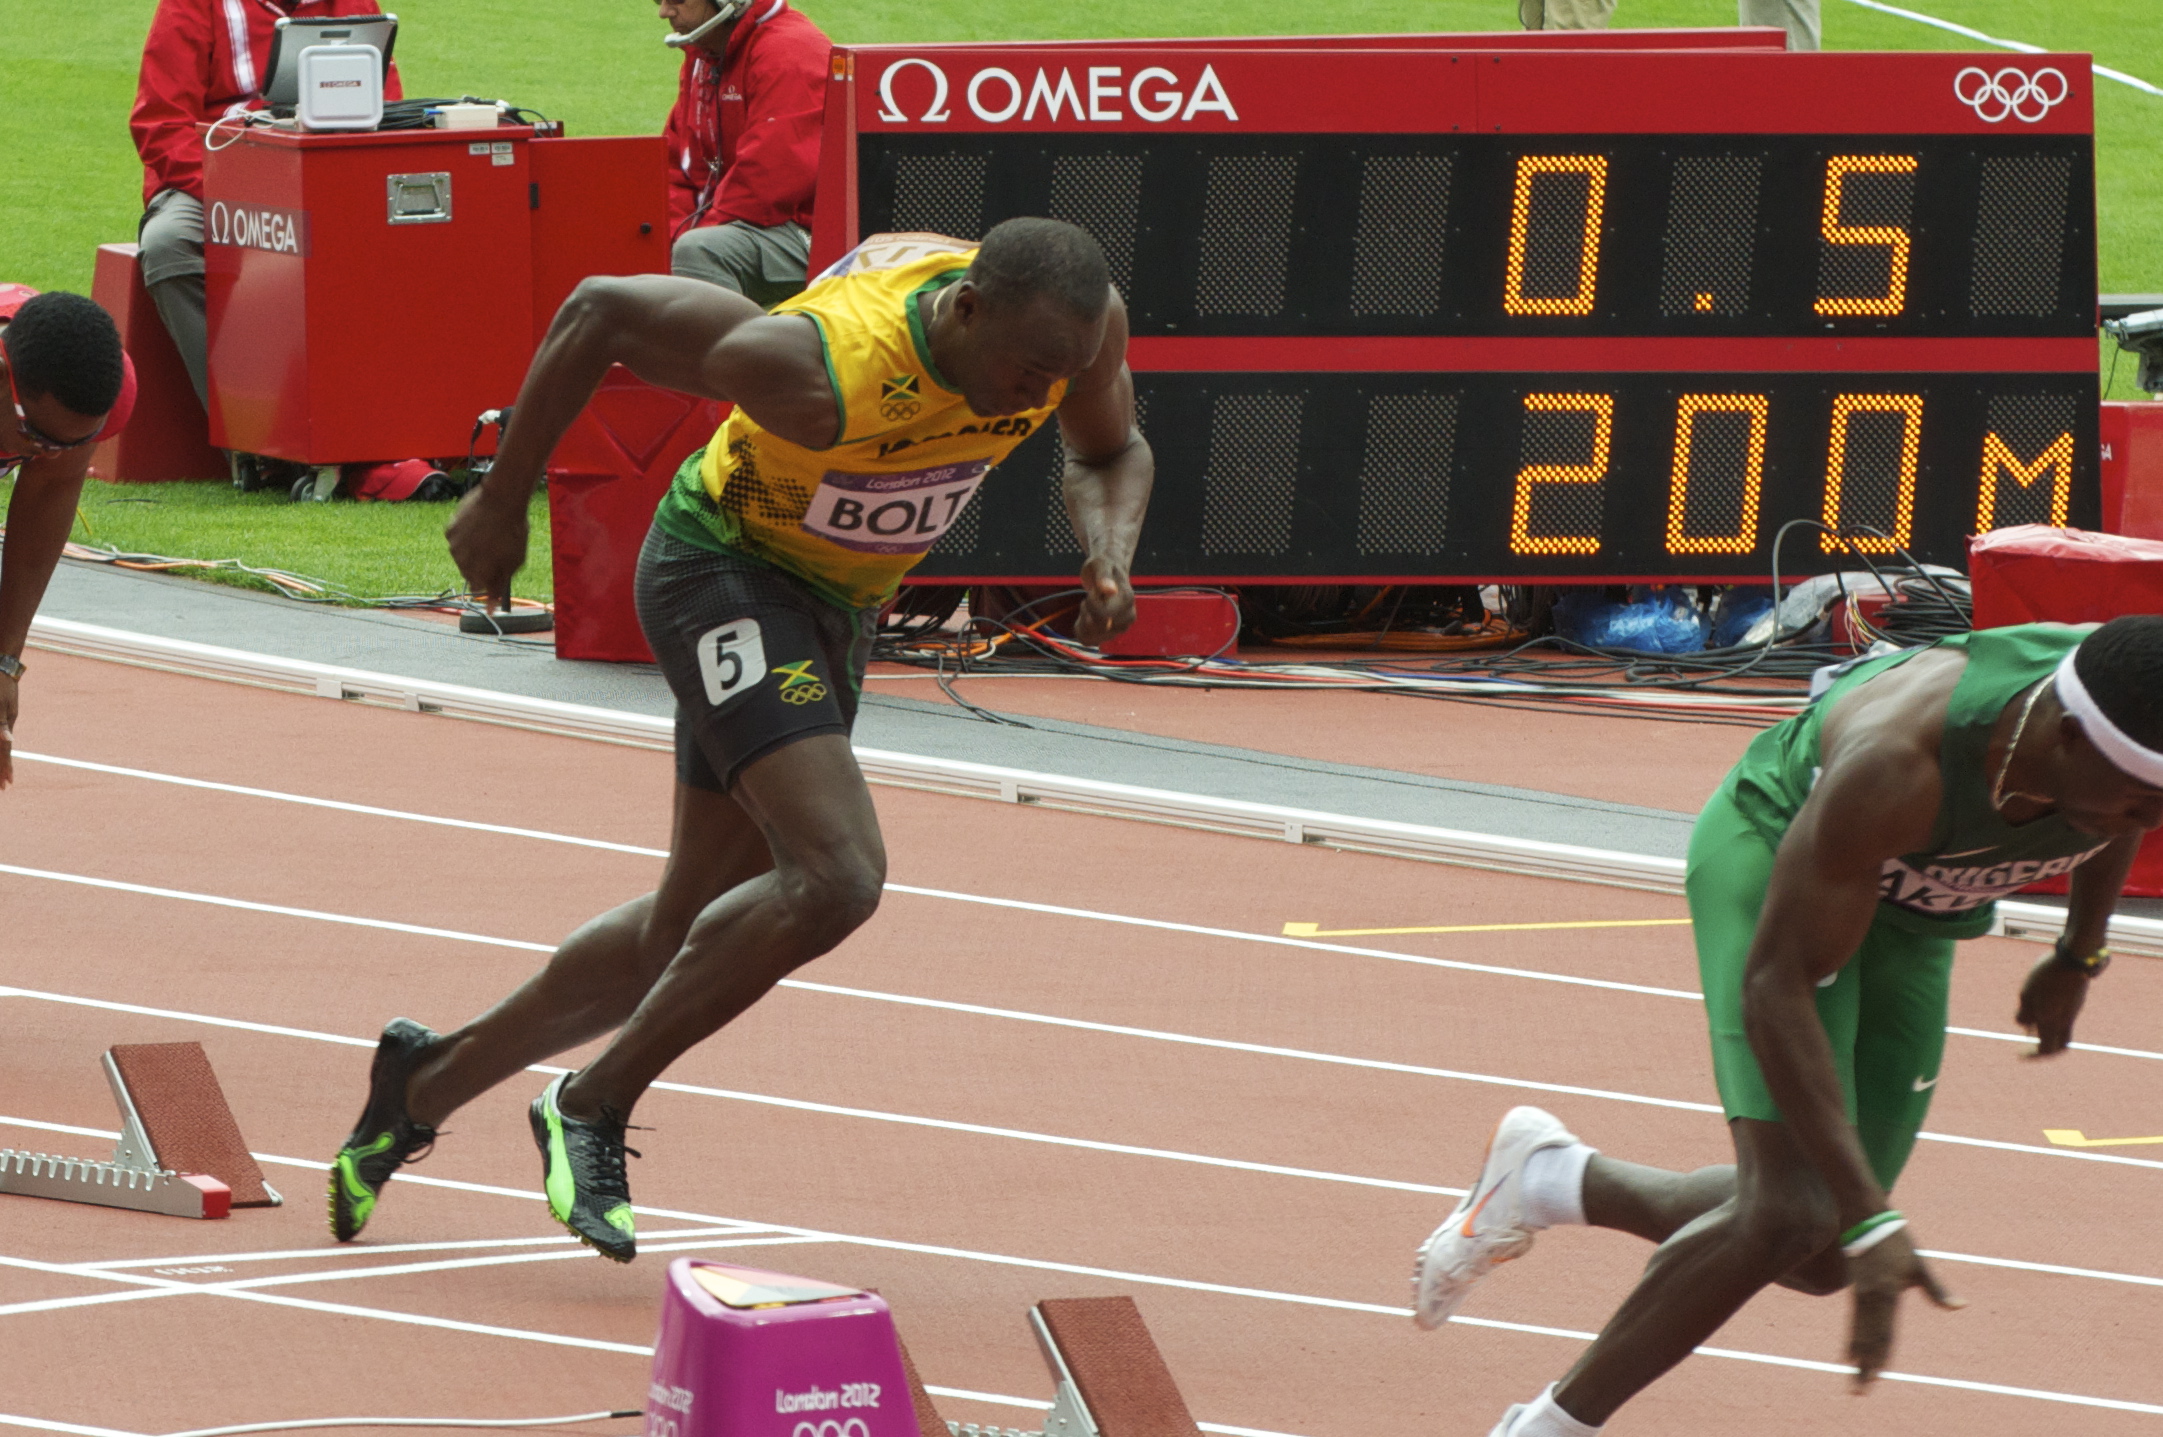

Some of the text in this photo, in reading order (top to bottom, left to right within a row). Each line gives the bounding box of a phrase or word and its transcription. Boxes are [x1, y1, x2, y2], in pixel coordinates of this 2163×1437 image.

[966, 63, 1239, 123] OMEGA
[233, 208, 298, 254] OMEGA
[866, 467, 957, 490] London 2012
[828, 486, 972, 536] BOLT
[716, 629, 743, 691] 5
[775, 1382, 881, 1414] London 2012
